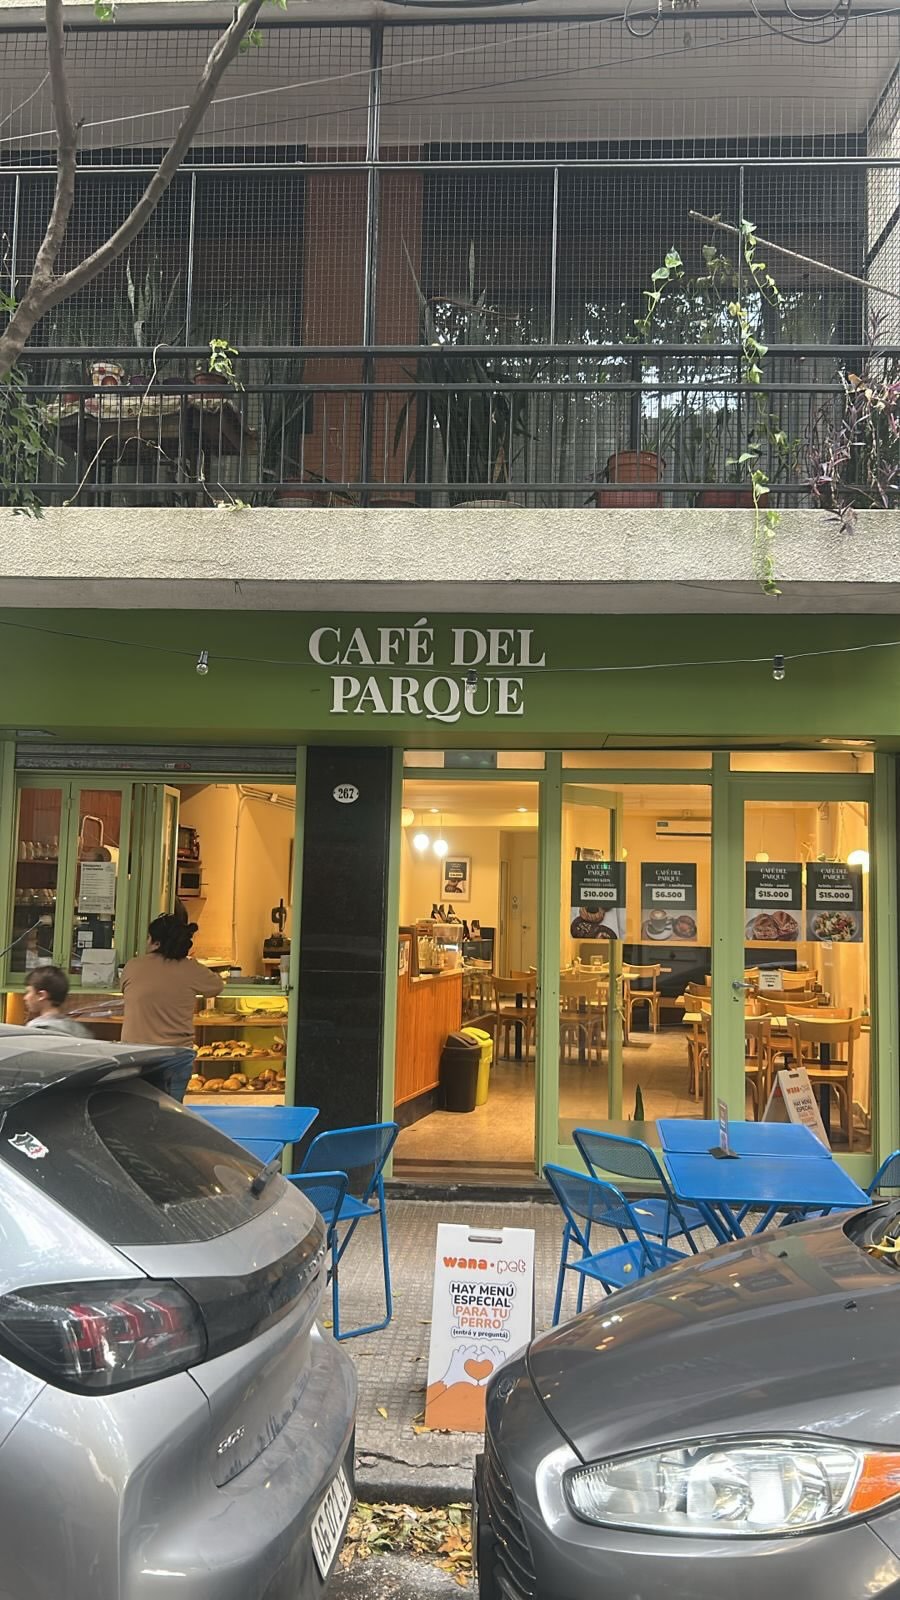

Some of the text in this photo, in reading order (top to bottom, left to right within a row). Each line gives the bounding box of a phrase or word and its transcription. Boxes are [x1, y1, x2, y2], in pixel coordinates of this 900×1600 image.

[308, 617, 546, 667] CAFÉ DEL
[329, 676, 524, 722] PARQUE
[338, 788, 354, 799] 267
[758, 890, 789, 898] $15.000
[819, 891, 850, 899] $15.000
[451, 1283, 514, 1297] HAY MENÚ
[454, 1295, 511, 1308] ESPECIAL
[455, 1306, 508, 1318] PARA TU
[460, 1317, 501, 1329] PERRO
[453, 1328, 472, 1336] (entrá
[478, 1330, 508, 1339] preguntá)
